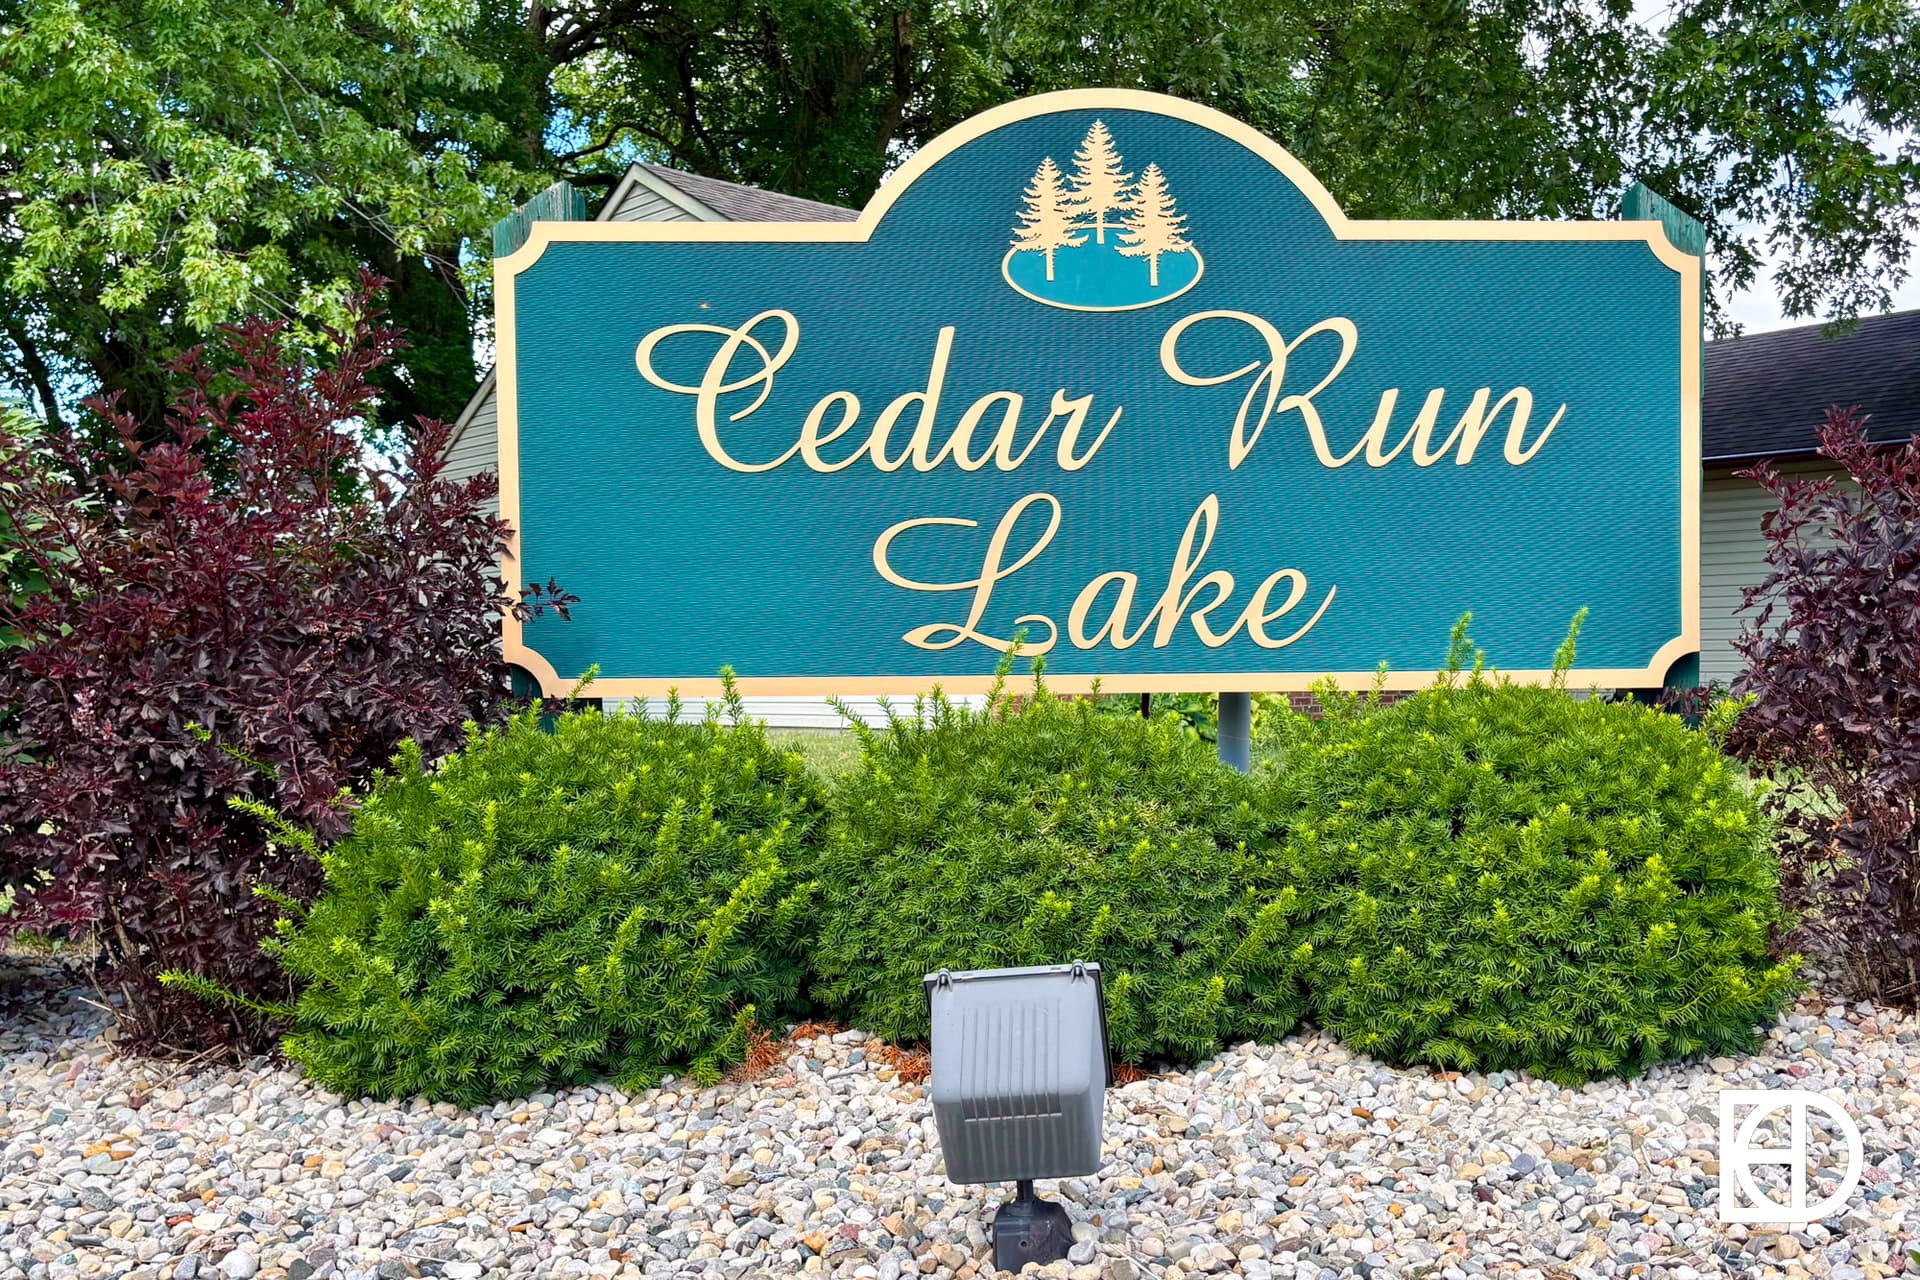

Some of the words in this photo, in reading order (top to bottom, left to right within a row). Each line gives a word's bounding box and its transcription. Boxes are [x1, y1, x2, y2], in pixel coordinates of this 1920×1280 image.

[635, 308, 1123, 473] Cedar
[1159, 309, 1567, 471] Run
[872, 492, 1337, 657] Lake
